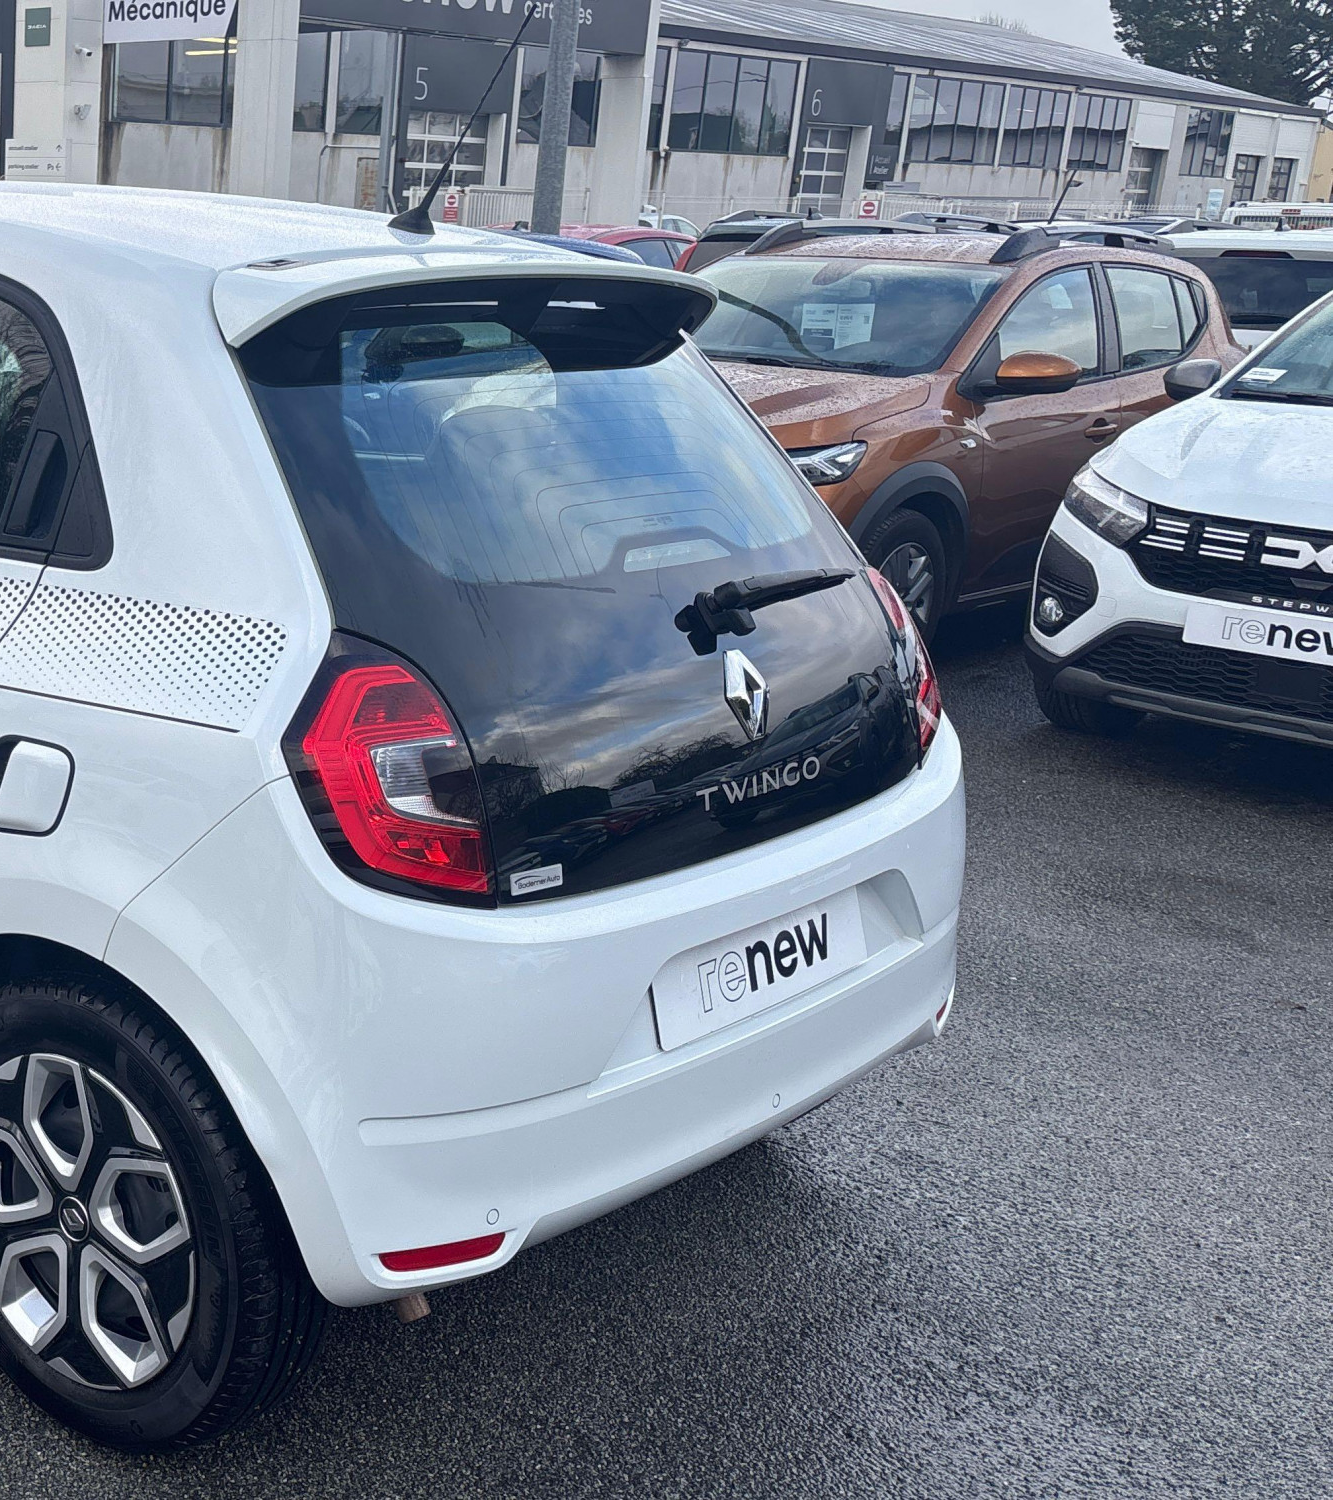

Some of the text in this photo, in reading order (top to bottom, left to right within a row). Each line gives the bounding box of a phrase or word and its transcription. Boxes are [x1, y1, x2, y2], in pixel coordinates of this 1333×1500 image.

[108, 0, 227, 23] Mécanique
[414, 67, 429, 101] 5
[811, 88, 824, 117] 6
[695, 756, 820, 812] TWINGO
[697, 912, 828, 1013] renew
